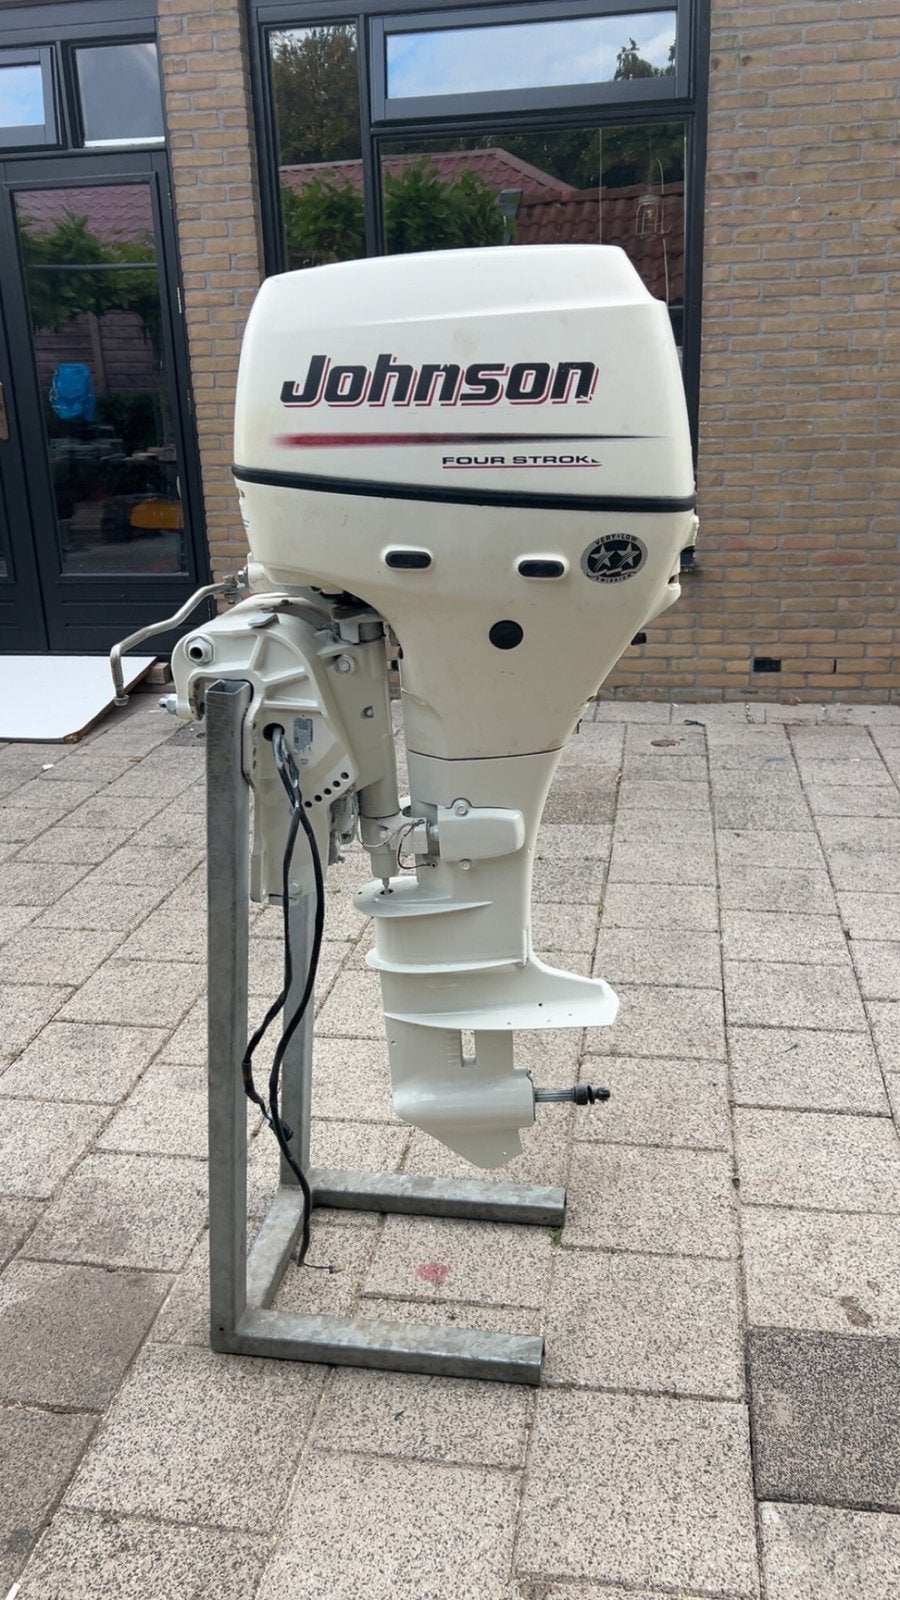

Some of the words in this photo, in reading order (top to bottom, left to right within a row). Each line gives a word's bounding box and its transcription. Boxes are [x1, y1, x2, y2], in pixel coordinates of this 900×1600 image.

[280, 353, 599, 407] Johnson
[442, 456, 505, 465] FOUR
[512, 455, 601, 464] STROK
